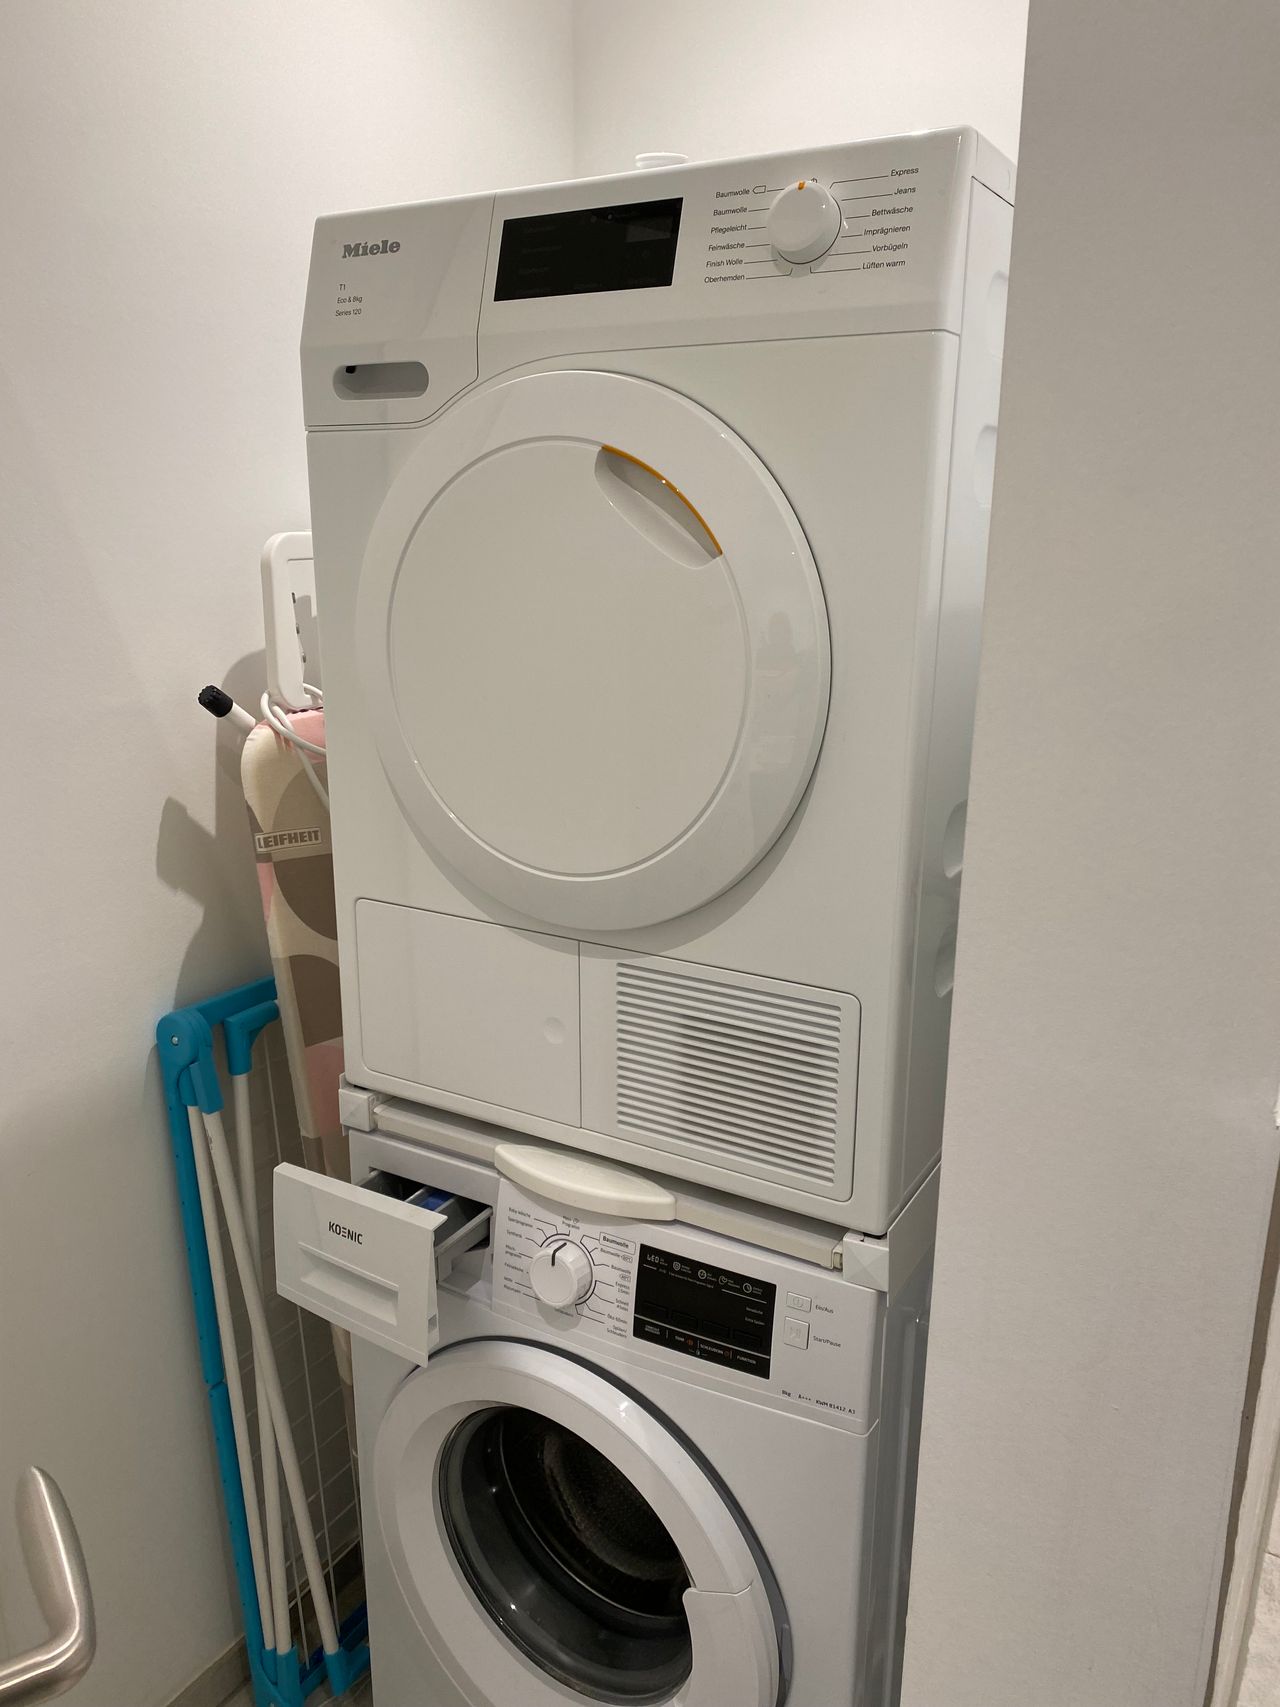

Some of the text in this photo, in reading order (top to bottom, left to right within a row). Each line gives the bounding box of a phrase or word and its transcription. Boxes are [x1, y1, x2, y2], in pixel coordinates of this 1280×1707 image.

[890, 166, 919, 177] Express
[715, 187, 750, 199] Baumwolle
[894, 186, 916, 195] Jeans
[713, 206, 748, 216] Baumwolle
[871, 206, 913, 217] Bettwäsche
[710, 223, 747, 234] Pflegeleicht
[863, 225, 911, 237] Imprägnieren
[342, 240, 400, 259] Miele
[708, 241, 745, 251] Feinwäsche
[872, 242, 908, 252] Vorbügeln
[706, 257, 744, 268] Finish Wolle
[862, 260, 884, 270] Lüften
[704, 274, 745, 284] Oberhemden
[257, 830, 319, 849] LEIFHEIT
[602, 1235, 629, 1248] Baumwolle
[813, 1335, 841, 1348] Start/Pause
